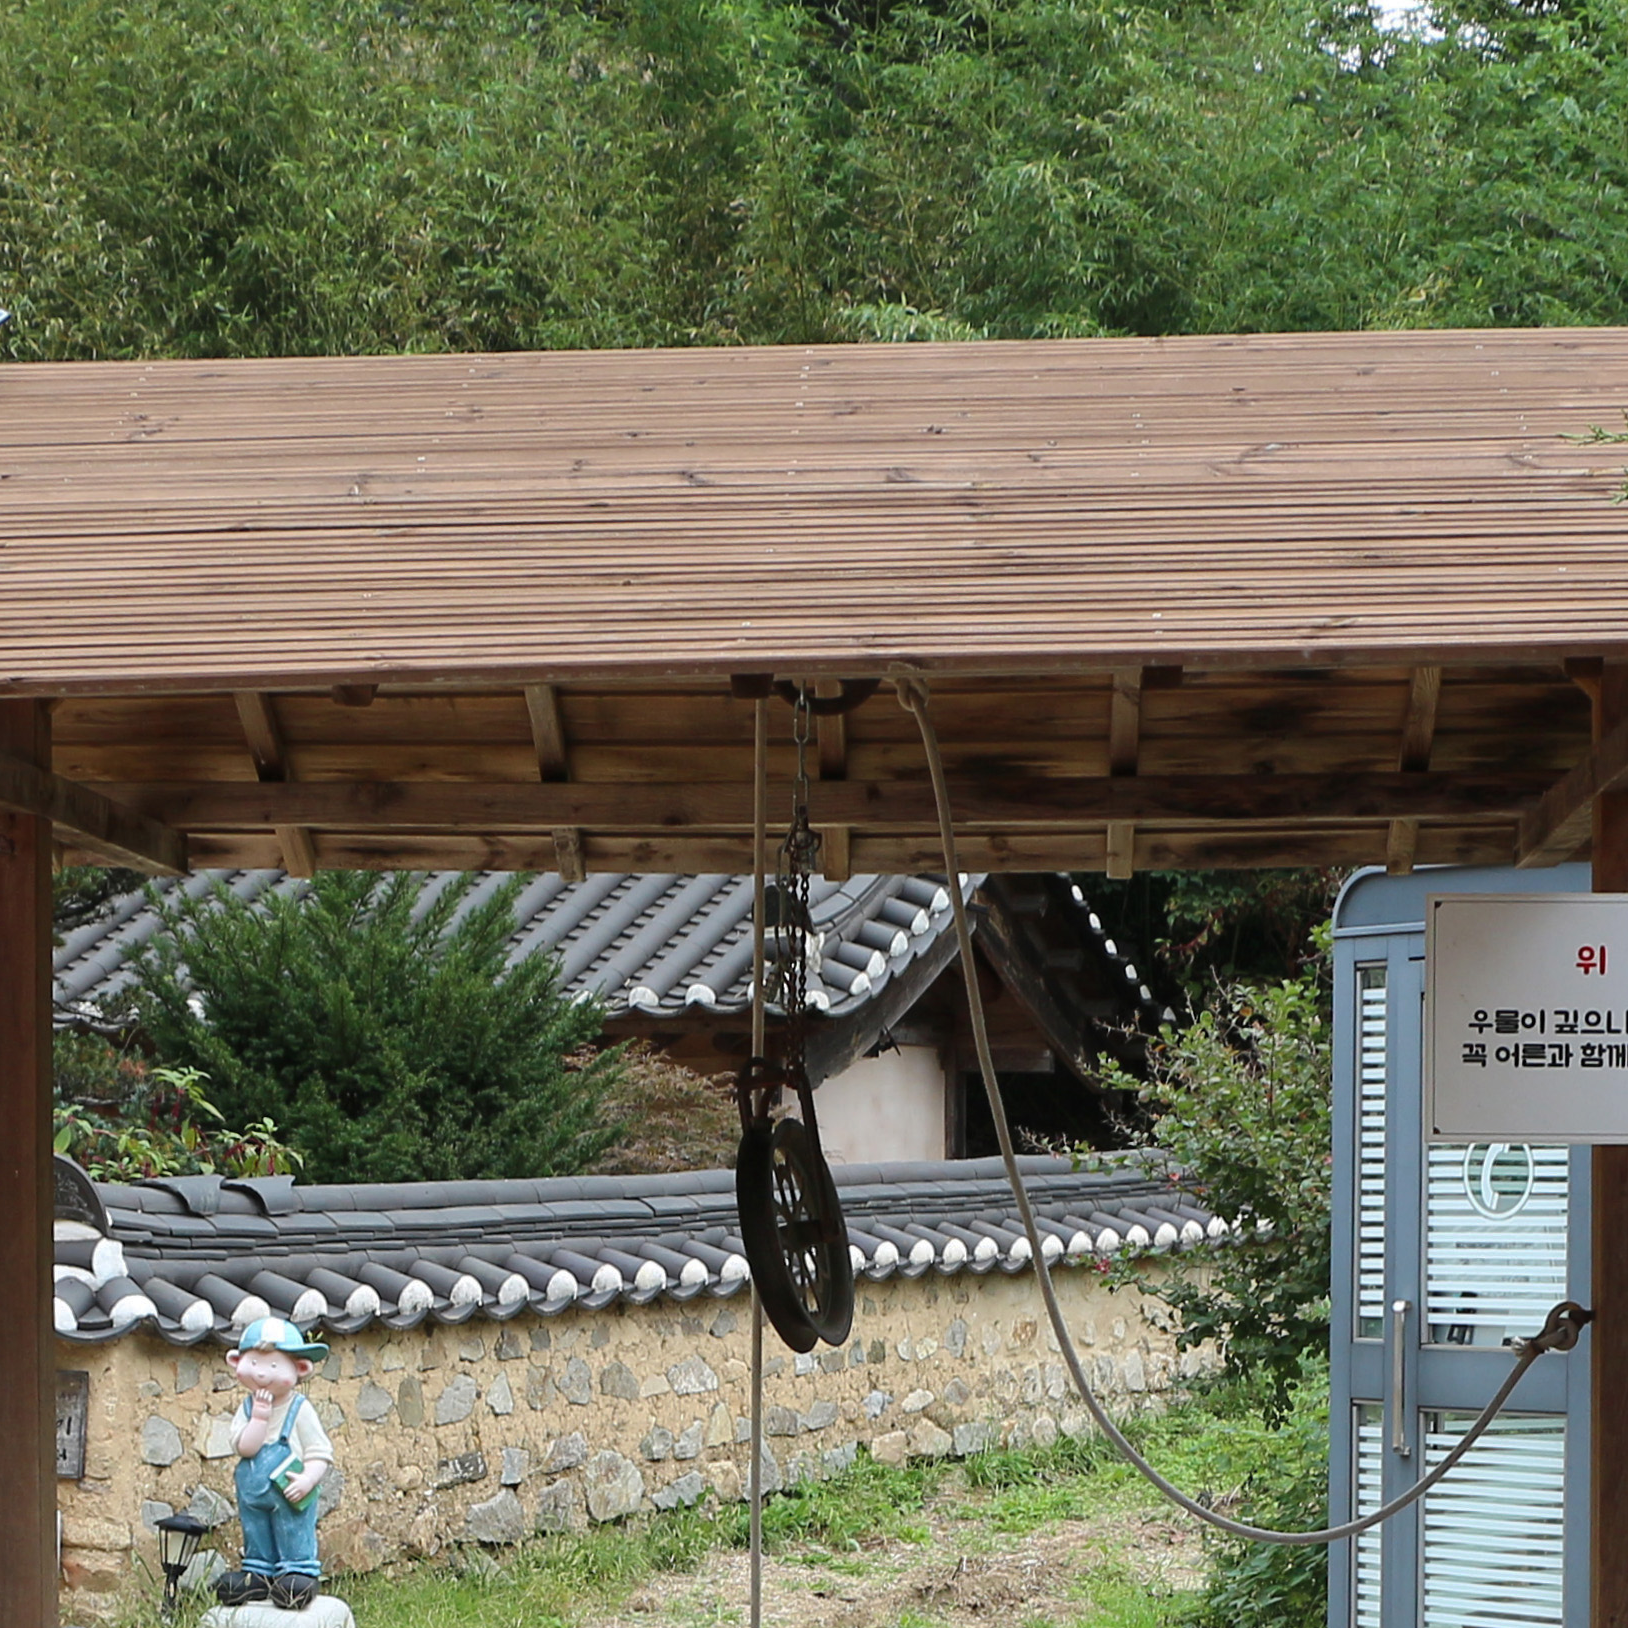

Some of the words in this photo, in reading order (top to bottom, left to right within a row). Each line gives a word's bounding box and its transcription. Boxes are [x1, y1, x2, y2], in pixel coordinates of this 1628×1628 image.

[1576, 945, 1606, 975] 위
[1468, 1009, 1545, 1034] 우물이
[1462, 1043, 1487, 1068] 꼭
[1495, 1043, 1573, 1068] 어른과
